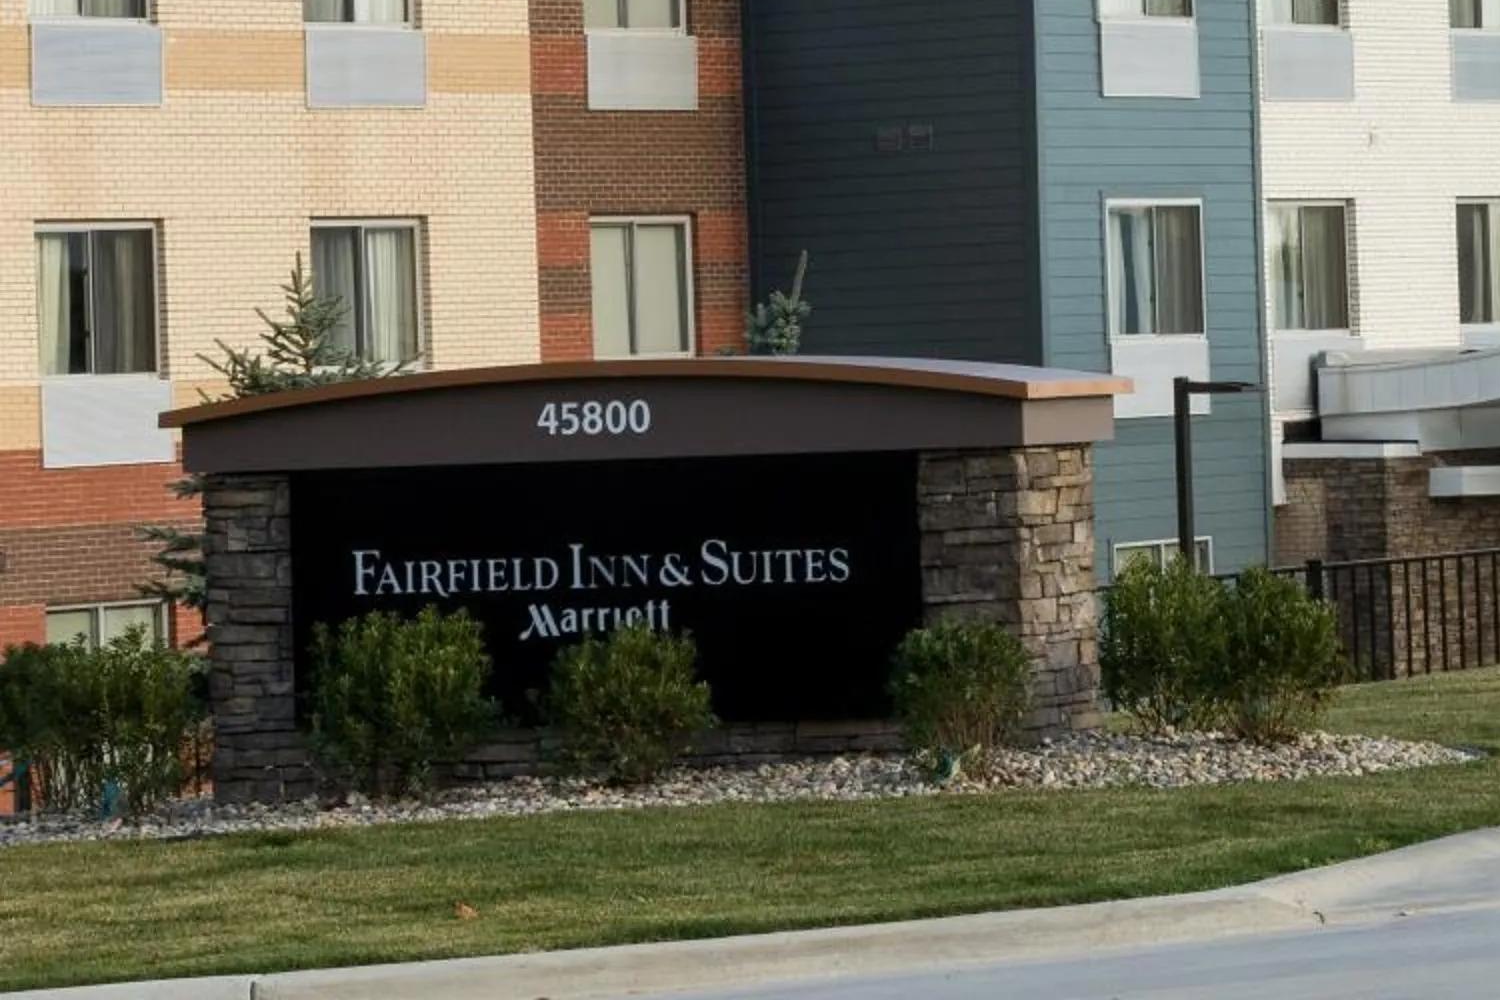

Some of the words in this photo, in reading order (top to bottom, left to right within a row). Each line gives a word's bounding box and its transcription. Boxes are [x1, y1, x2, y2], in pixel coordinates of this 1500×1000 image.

[537, 400, 651, 436] 45800
[351, 549, 560, 599] FAIRFIELD
[568, 543, 651, 589] INN
[658, 552, 695, 588] &
[700, 538, 850, 586] SUITES
[518, 599, 671, 641] Marriott
